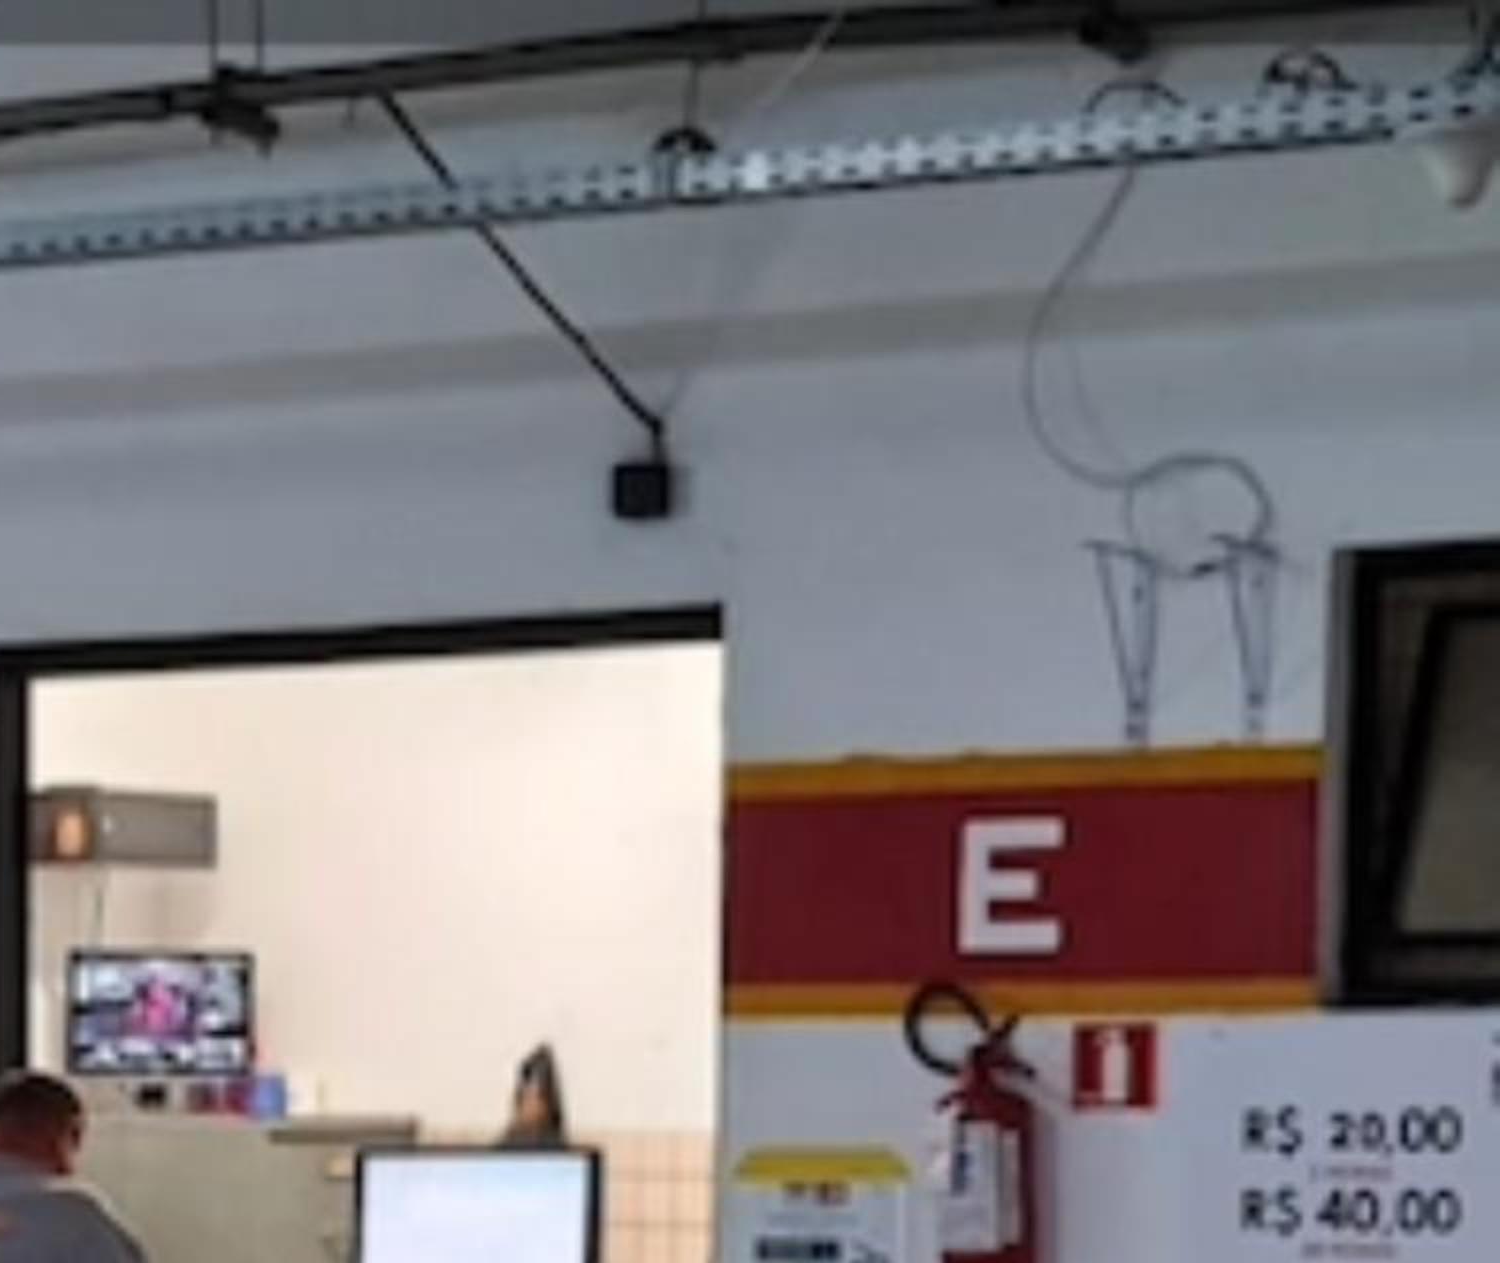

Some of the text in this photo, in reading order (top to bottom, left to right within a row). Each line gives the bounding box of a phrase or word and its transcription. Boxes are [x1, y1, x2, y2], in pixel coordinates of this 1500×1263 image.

[956, 815, 1067, 955] E
[1241, 1105, 1303, 1156] R$
[1239, 1188, 1303, 1237] R$
